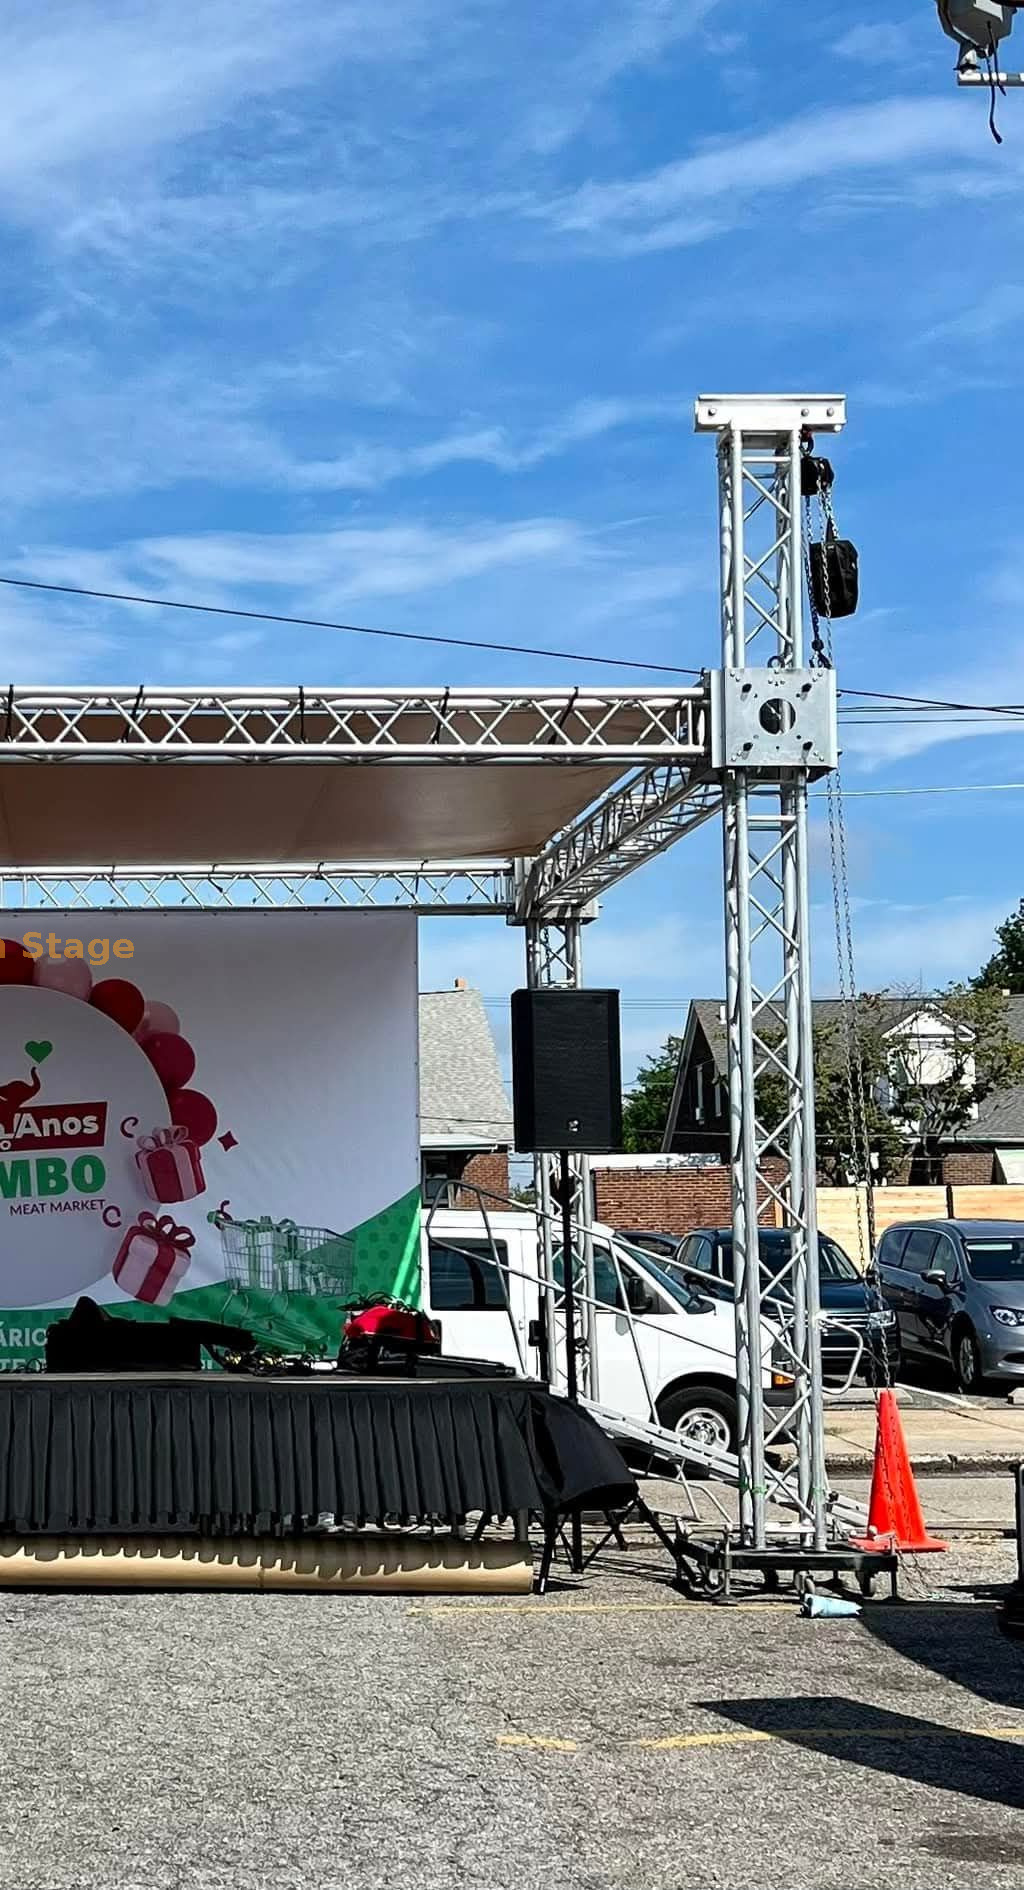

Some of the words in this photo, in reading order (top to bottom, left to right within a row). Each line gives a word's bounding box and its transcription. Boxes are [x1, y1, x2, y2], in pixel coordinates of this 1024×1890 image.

[14, 1112, 99, 1139] Anos
[10, 1202, 46, 1217] MEAT
[49, 1199, 107, 1214] MARKET
